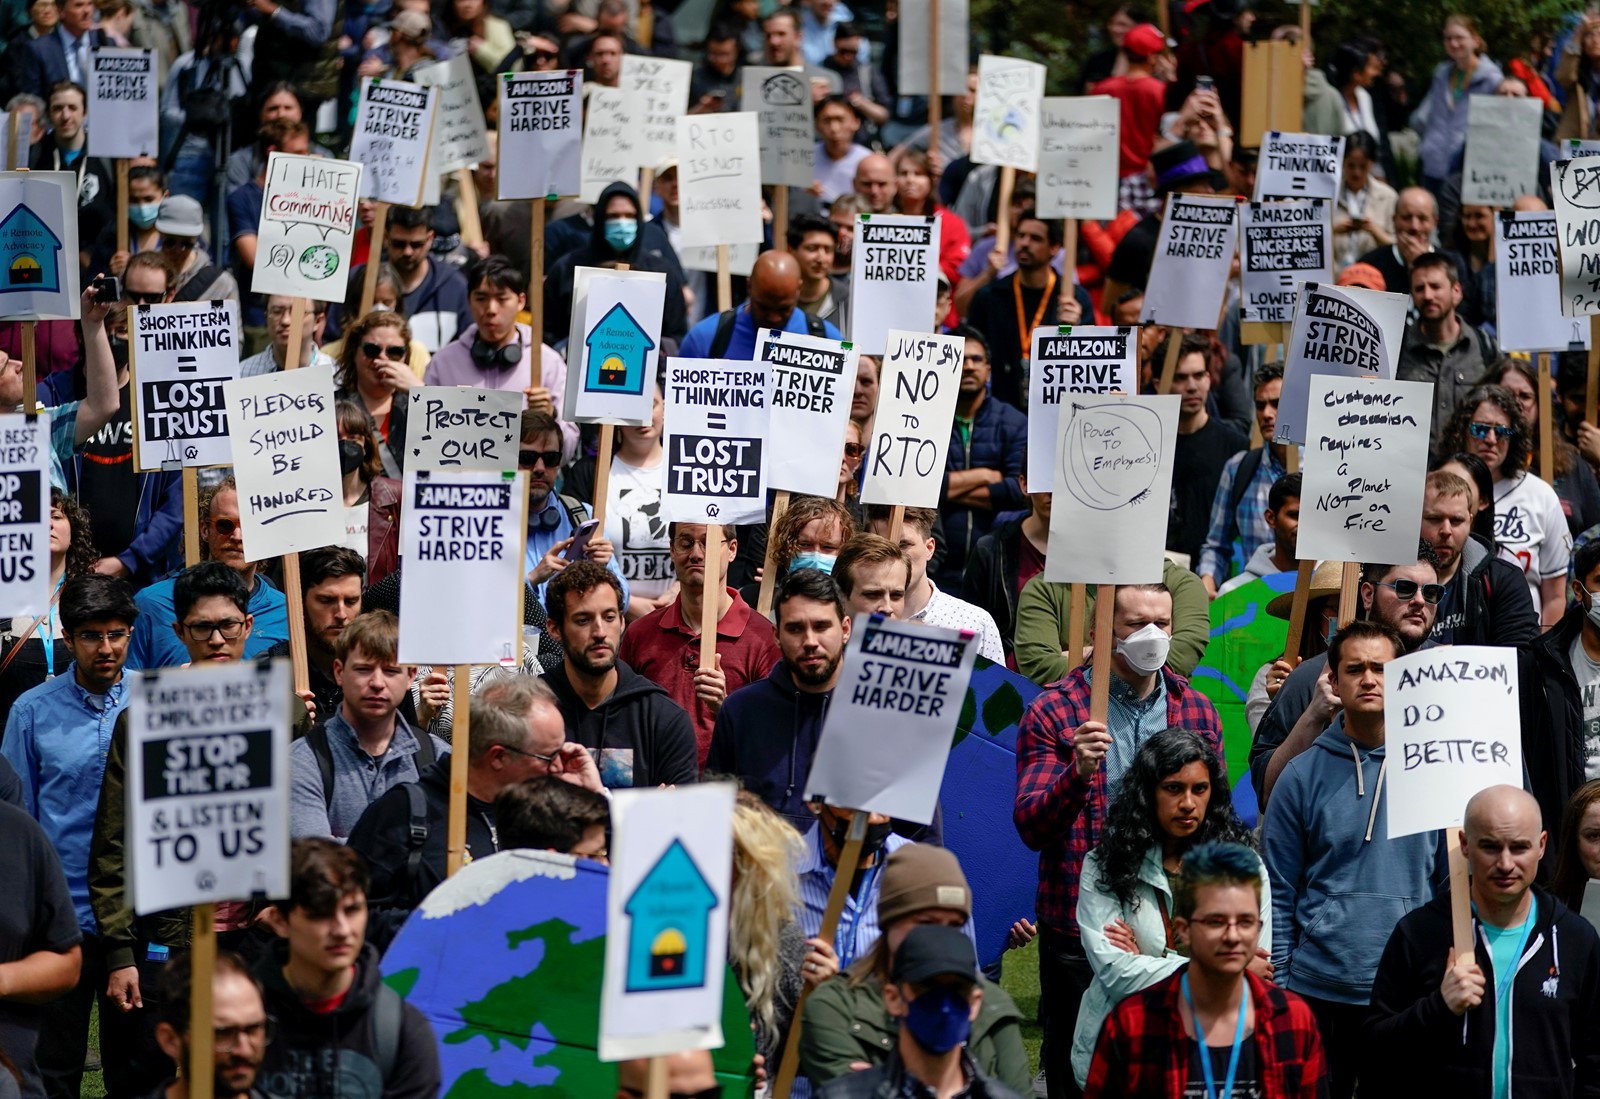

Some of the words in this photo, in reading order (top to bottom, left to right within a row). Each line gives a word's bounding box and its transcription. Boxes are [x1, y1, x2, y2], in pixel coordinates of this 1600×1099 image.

[98, 75, 146, 88] STRIVE
[98, 89, 147, 100] HARDER
[367, 106, 421, 126] STRIVE
[511, 100, 570, 116] STRIVE
[364, 123, 419, 141] HARDER
[511, 116, 570, 131] HARDER
[688, 123, 736, 151] RTO
[1269, 142, 1338, 156] SHORT-TERM
[689, 159, 709, 173] IS
[714, 157, 744, 170] NOT
[1268, 155, 1336, 173] THINKING
[301, 160, 353, 195] HATE
[1169, 225, 1228, 244] STRIVE
[1270, 226, 1322, 238] EMISSIONS
[1508, 221, 1557, 237] AMAZO
[865, 248, 926, 265] STRIVE
[1166, 242, 1223, 259] HARDER
[1252, 239, 1318, 254] INCREASE
[1250, 254, 1293, 270] SINCE
[864, 265, 926, 282] HARDER
[139, 311, 231, 331] SHORT-TERM
[1257, 307, 1285, 320] THE
[140, 329, 231, 352] THINKING
[606, 328, 635, 337] Remote
[1307, 321, 1380, 358] STRIVE
[599, 341, 635, 352] Advocacy
[891, 337, 938, 363] JUST
[937, 342, 962, 374] SAY
[1303, 341, 1380, 373] HARDER
[672, 369, 765, 386] SHORT-TERM
[771, 369, 836, 395] TRIVE
[1042, 364, 1122, 384] STRIVE
[152, 381, 222, 410] LOST
[895, 368, 939, 404] NO
[240, 393, 325, 420] PLEDGES
[672, 386, 764, 408] THINKING
[772, 392, 834, 413] ARDER
[1324, 390, 1404, 408] Customer
[147, 409, 228, 438] TRUST
[426, 400, 517, 432] PROTECT
[901, 414, 920, 429] TO
[249, 423, 324, 456] SHOULD
[441, 438, 499, 460] OUR
[1102, 439, 1121, 450] TO
[1320, 435, 1383, 460] requires
[680, 438, 751, 467] LOST
[872, 432, 937, 477] RTO
[272, 454, 303, 475] BE
[672, 465, 757, 494] TRUST
[1348, 478, 1392, 493] Planet
[421, 487, 505, 507] AMAZON:
[1316, 493, 1364, 512] NOT
[1369, 503, 1391, 514] on
[419, 516, 503, 538] STRIVE
[1344, 513, 1387, 532] Fire
[419, 540, 503, 561] HARDER
[1, 556, 35, 583] US
[867, 633, 958, 662] AMAZON:
[859, 661, 951, 695] STRIVE
[852, 685, 944, 717] HARDER
[1404, 704, 1444, 727] DO
[165, 735, 249, 770] STOP
[1404, 740, 1511, 771] BETTER
[163, 768, 212, 794] THE
[215, 763, 251, 789] PR
[176, 802, 264, 829] LISTEN
[150, 834, 197, 867] TO
[220, 827, 264, 858] US
